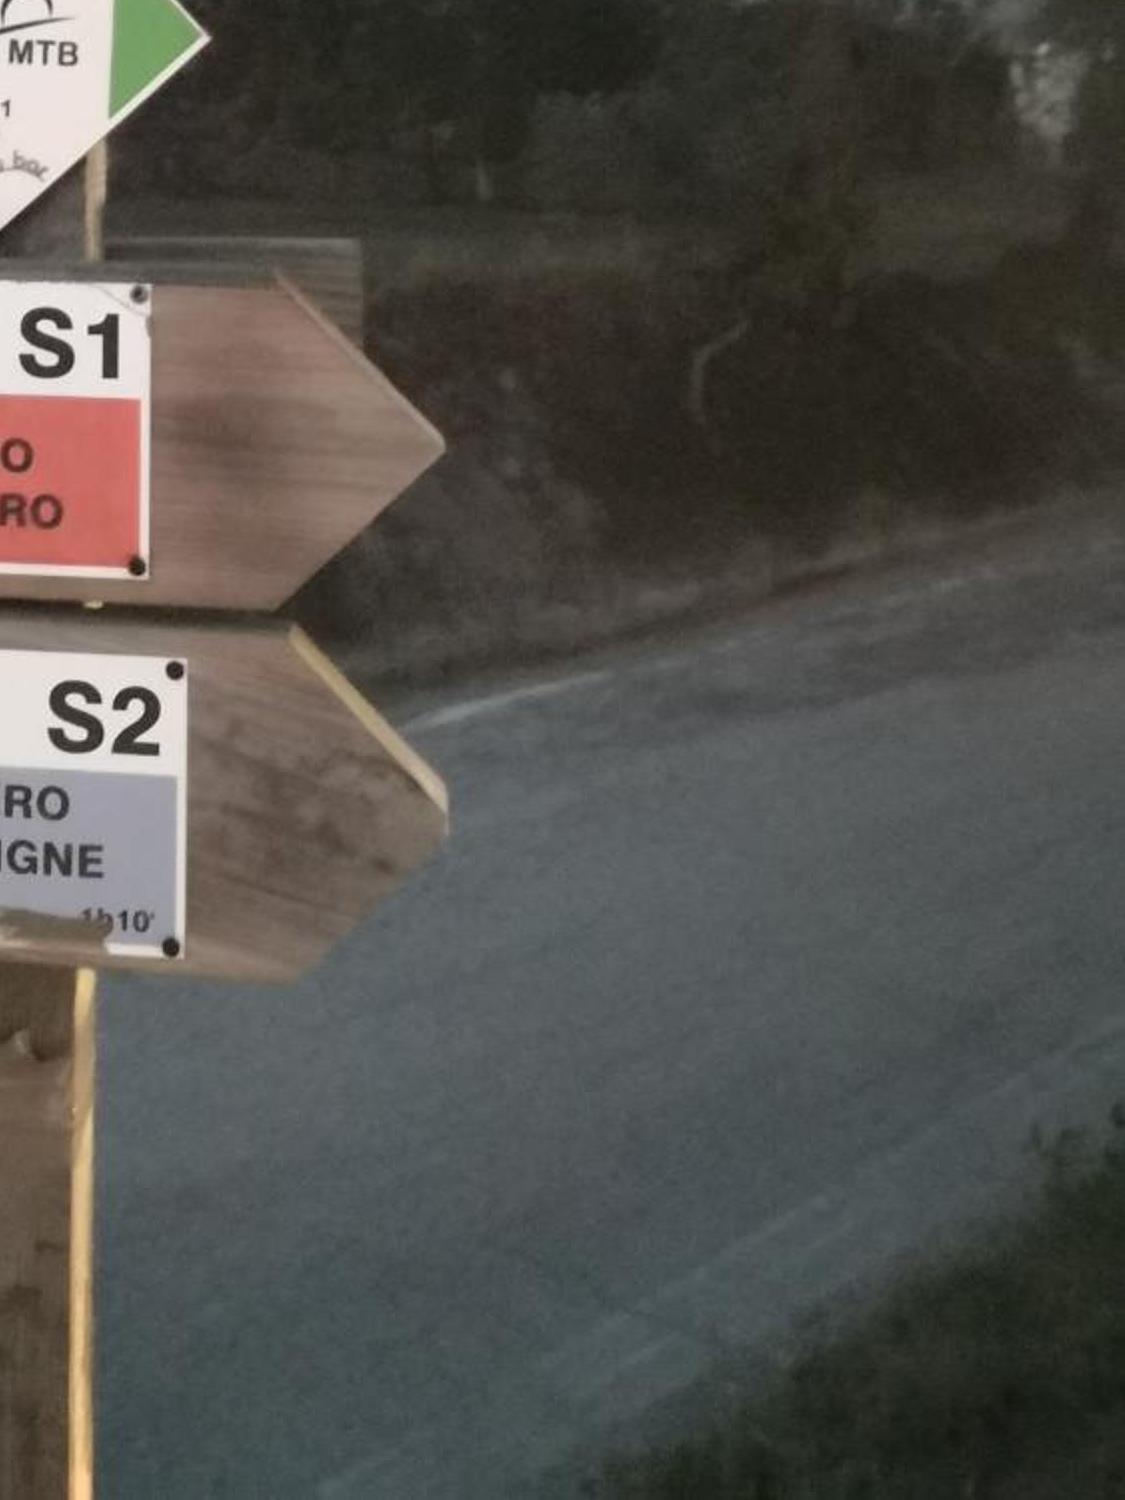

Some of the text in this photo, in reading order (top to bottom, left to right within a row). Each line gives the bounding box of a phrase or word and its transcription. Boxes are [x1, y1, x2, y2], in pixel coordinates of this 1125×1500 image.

[8, 38, 79, 67] MTB
[18, 306, 120, 380] S1
[47, 679, 162, 757] S2
